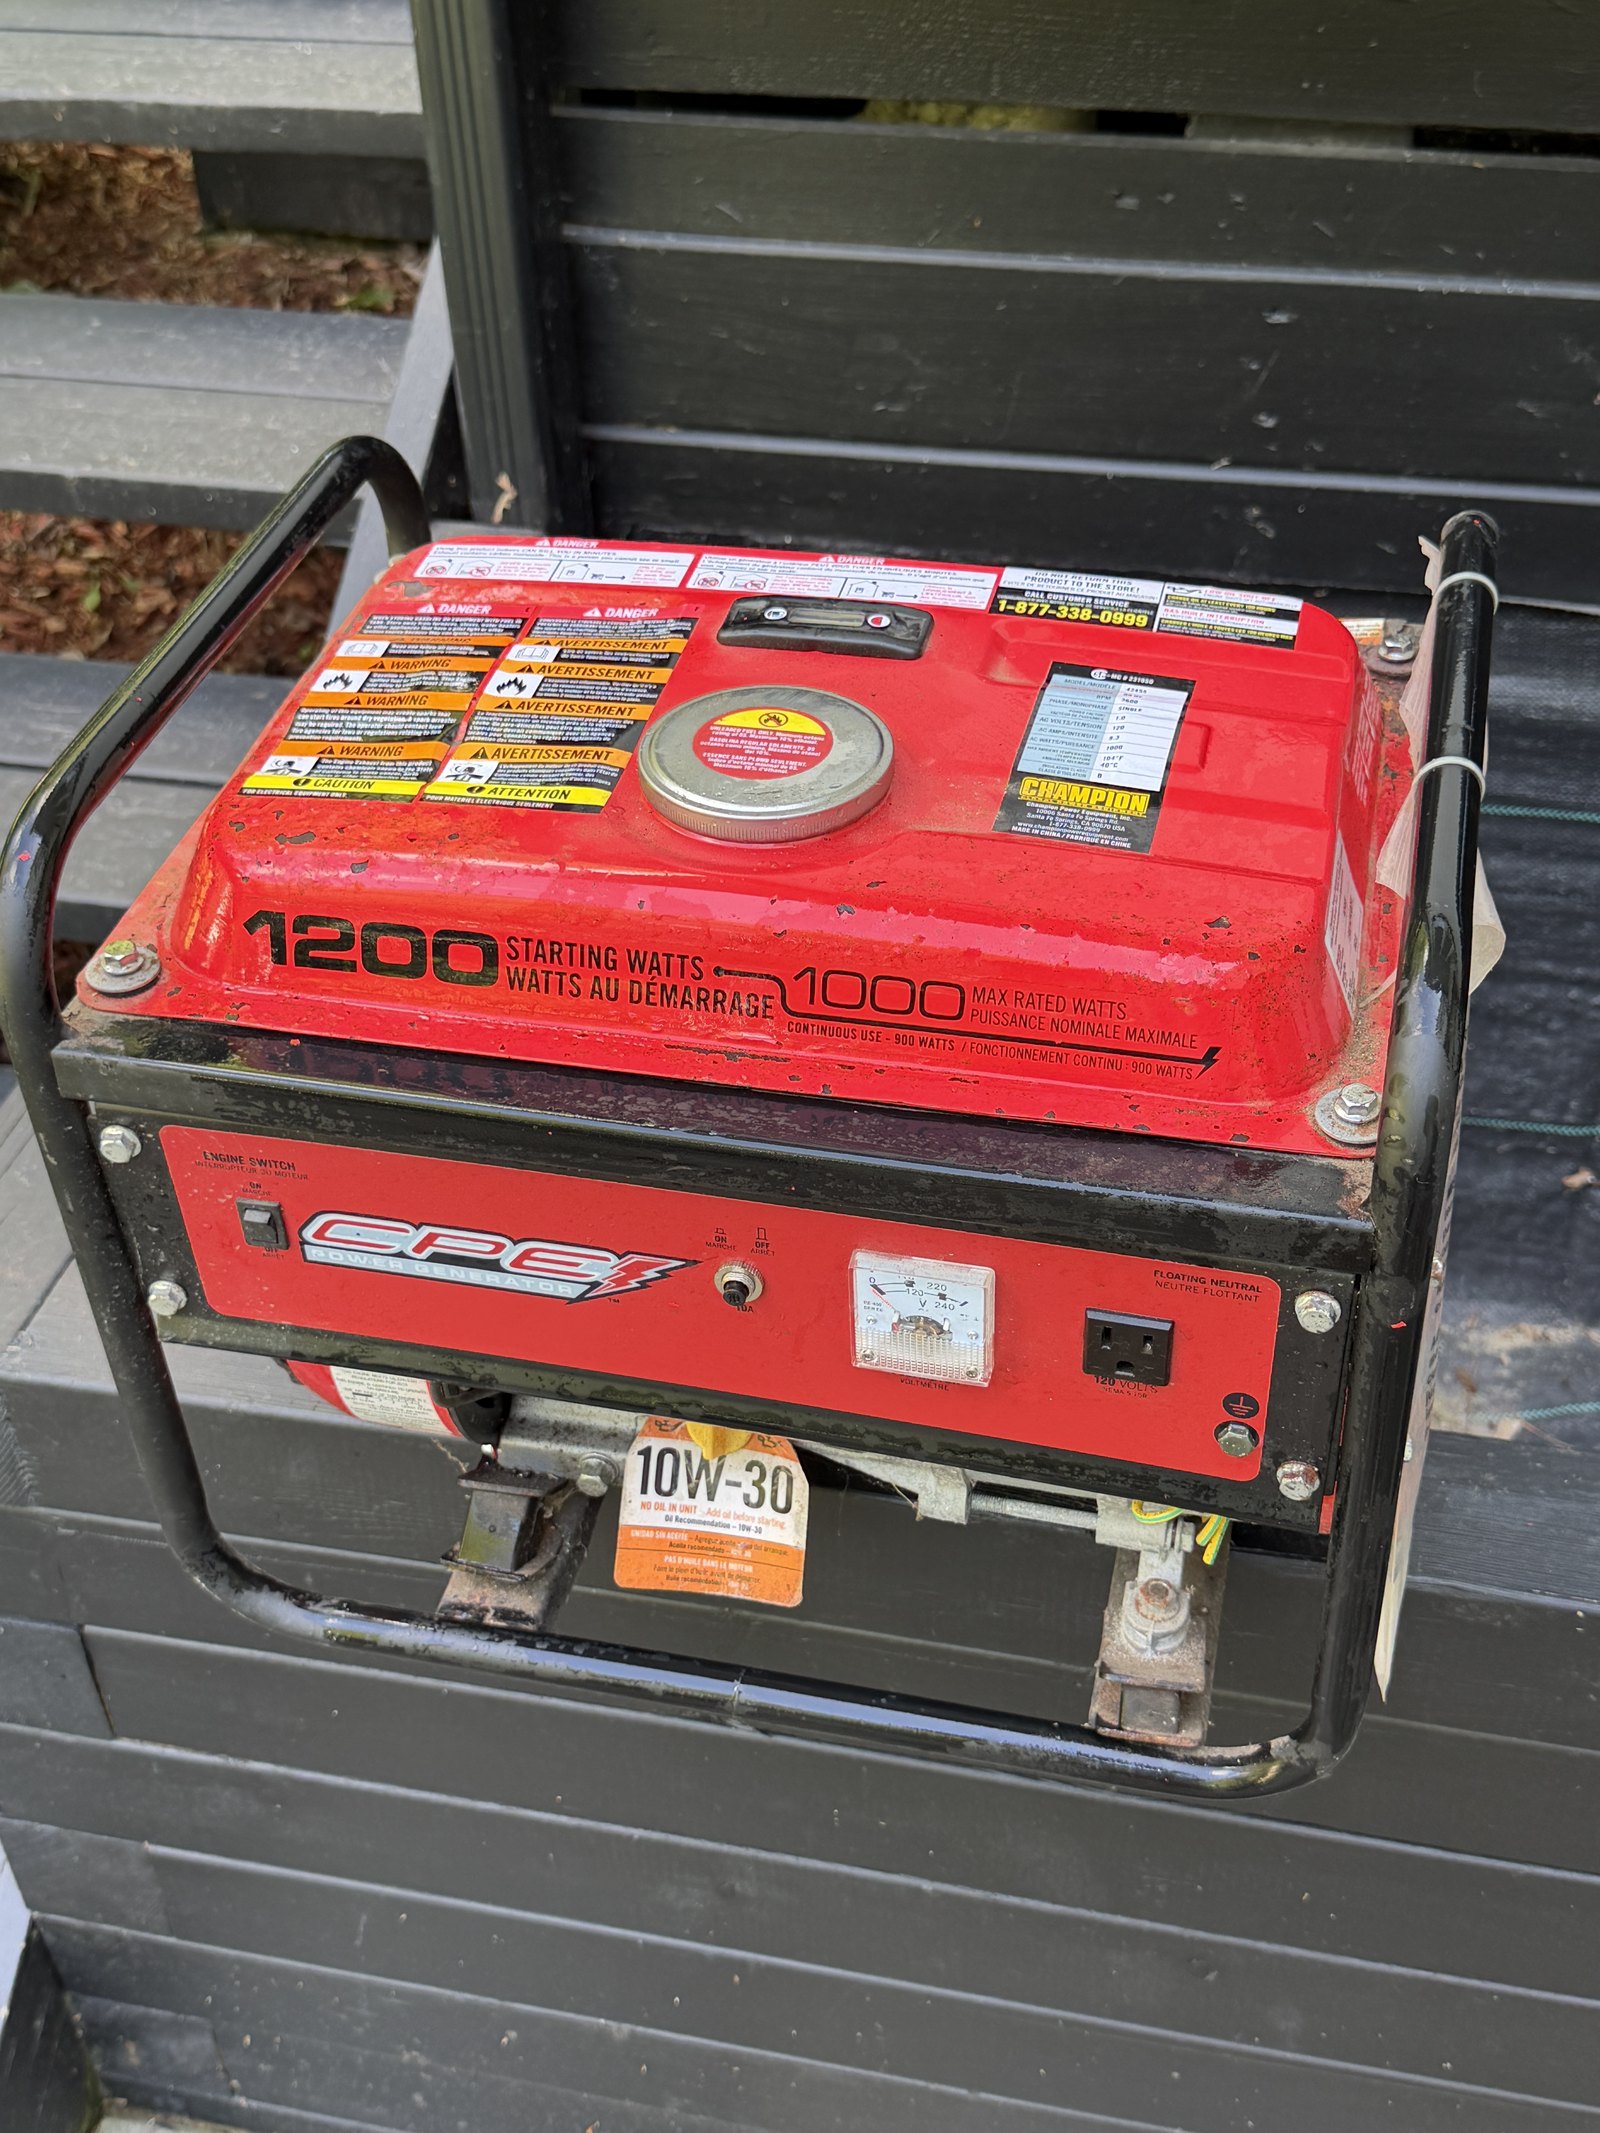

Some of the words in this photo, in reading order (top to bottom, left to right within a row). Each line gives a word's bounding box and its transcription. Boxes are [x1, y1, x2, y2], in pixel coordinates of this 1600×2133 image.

[552, 539, 599, 548] DANGER
[837, 555, 885, 565] DANGER
[1024, 576, 1069, 586] PRODUCT
[1105, 583, 1140, 593] STORE!
[1024, 590, 1045, 599] CALL
[1046, 593, 1092, 605] CUSTOMER
[1093, 598, 1130, 608] SERVICE
[437, 604, 492, 615] DANGER
[604, 607, 658, 618] DANGER
[998, 599, 1148, 628] 1-877-338-0999
[556, 639, 671, 650] AVERTISSEMENT
[390, 659, 451, 671] WARNING
[536, 665, 655, 680] AVERTISSEMENT
[366, 695, 429, 706] WARNING
[515, 701, 636, 717] AVERTISSEMENT
[1050, 718, 1102, 730] VOLTS/TENSION
[339, 746, 404, 757] WARNING
[490, 748, 613, 762] AVERTISSEMENT
[703, 752, 730, 760] ESSENCE
[312, 779, 376, 790] CAUTION
[488, 786, 572, 800] ATTENTION
[1020, 778, 1149, 812] CHAMPION
[1026, 801, 1058, 810] Champion
[1081, 809, 1118, 819] Equipment,
[1119, 814, 1132, 822] Inc.
[1026, 812, 1045, 820] Santa
[1049, 821, 1100, 832] 1-877-338-0999
[1084, 815, 1108, 824] Springs
[1011, 825, 1030, 833] MADE
[1040, 830, 1060, 838] CHINA
[1110, 840, 1132, 848] CHINE
[242, 908, 499, 987] 1200
[506, 934, 618, 972] STARTING
[626, 948, 705, 981] WATTS
[505, 966, 582, 1000] WATTS
[588, 980, 620, 1002] AU
[628, 975, 775, 1020] DÉMARRAGE
[792, 966, 966, 1022] 1000
[971, 986, 1007, 1006] MAX
[1014, 991, 1067, 1013] RATED
[1072, 997, 1127, 1020] WATTS
[970, 1009, 1046, 1031] PUISSANCE
[1050, 1018, 1121, 1040] NOMINALE
[1125, 1026, 1199, 1049] MAXIMALE
[787, 1022, 857, 1040] CONTINUOUS
[861, 1030, 882, 1043] USE
[894, 1033, 915, 1047] 900
[918, 1036, 955, 1051] WATTS
[970, 1042, 1070, 1065] FONCTIONNEMENT
[1073, 1054, 1123, 1071] CONTINU
[1131, 1062, 1152, 1074] 900
[1155, 1063, 1193, 1080] WATTS
[203, 1151, 245, 1165] ENGINE
[249, 1157, 296, 1171] SWITCH
[274, 1171, 309, 1180] MOTEUR
[706, 1241, 737, 1251] MARCHE
[714, 1235, 727, 1243] ON
[755, 1241, 770, 1249] OFF
[305, 1213, 620, 1283] CPE
[310, 1248, 404, 1272] POWER
[414, 1262, 573, 1295] GENERATOR
[926, 1282, 947, 1292] 220
[1153, 1269, 1206, 1284] FLOATING
[1210, 1278, 1262, 1293] NEUTRAL
[906, 1288, 924, 1297] 120
[1155, 1280, 1199, 1294] NEUTRE
[1203, 1288, 1260, 1302] FLOTTANT
[920, 1299, 927, 1308] V
[934, 1301, 955, 1311] 240
[1094, 1376, 1116, 1386] 120
[1120, 1380, 1158, 1394] VOLTS
[636, 1445, 794, 1515] 10W-30
[640, 1501, 652, 1510] NO
[654, 1502, 665, 1511] OIL
[668, 1503, 677, 1512] IN
[679, 1504, 697, 1514] UNIT
[706, 1508, 722, 1518] Add
[722, 1510, 732, 1518] oil
[733, 1512, 756, 1523] before
[757, 1515, 786, 1530] starting.
[664, 1514, 673, 1522] Oil
[675, 1516, 730, 1529] Recommendation
[738, 1523, 762, 1534] 10W-30
[631, 1529, 654, 1538] UNIDAD
[655, 1530, 667, 1538] SIN
[667, 1531, 689, 1541] ACEITE
[668, 1541, 686, 1549] Aceite
[664, 1555, 677, 1564] PAS
[678, 1556, 701, 1566] D'HUILE
[703, 1558, 718, 1568] DANS
[720, 1560, 727, 1568] LE
[729, 1561, 754, 1572] MOTEUR
